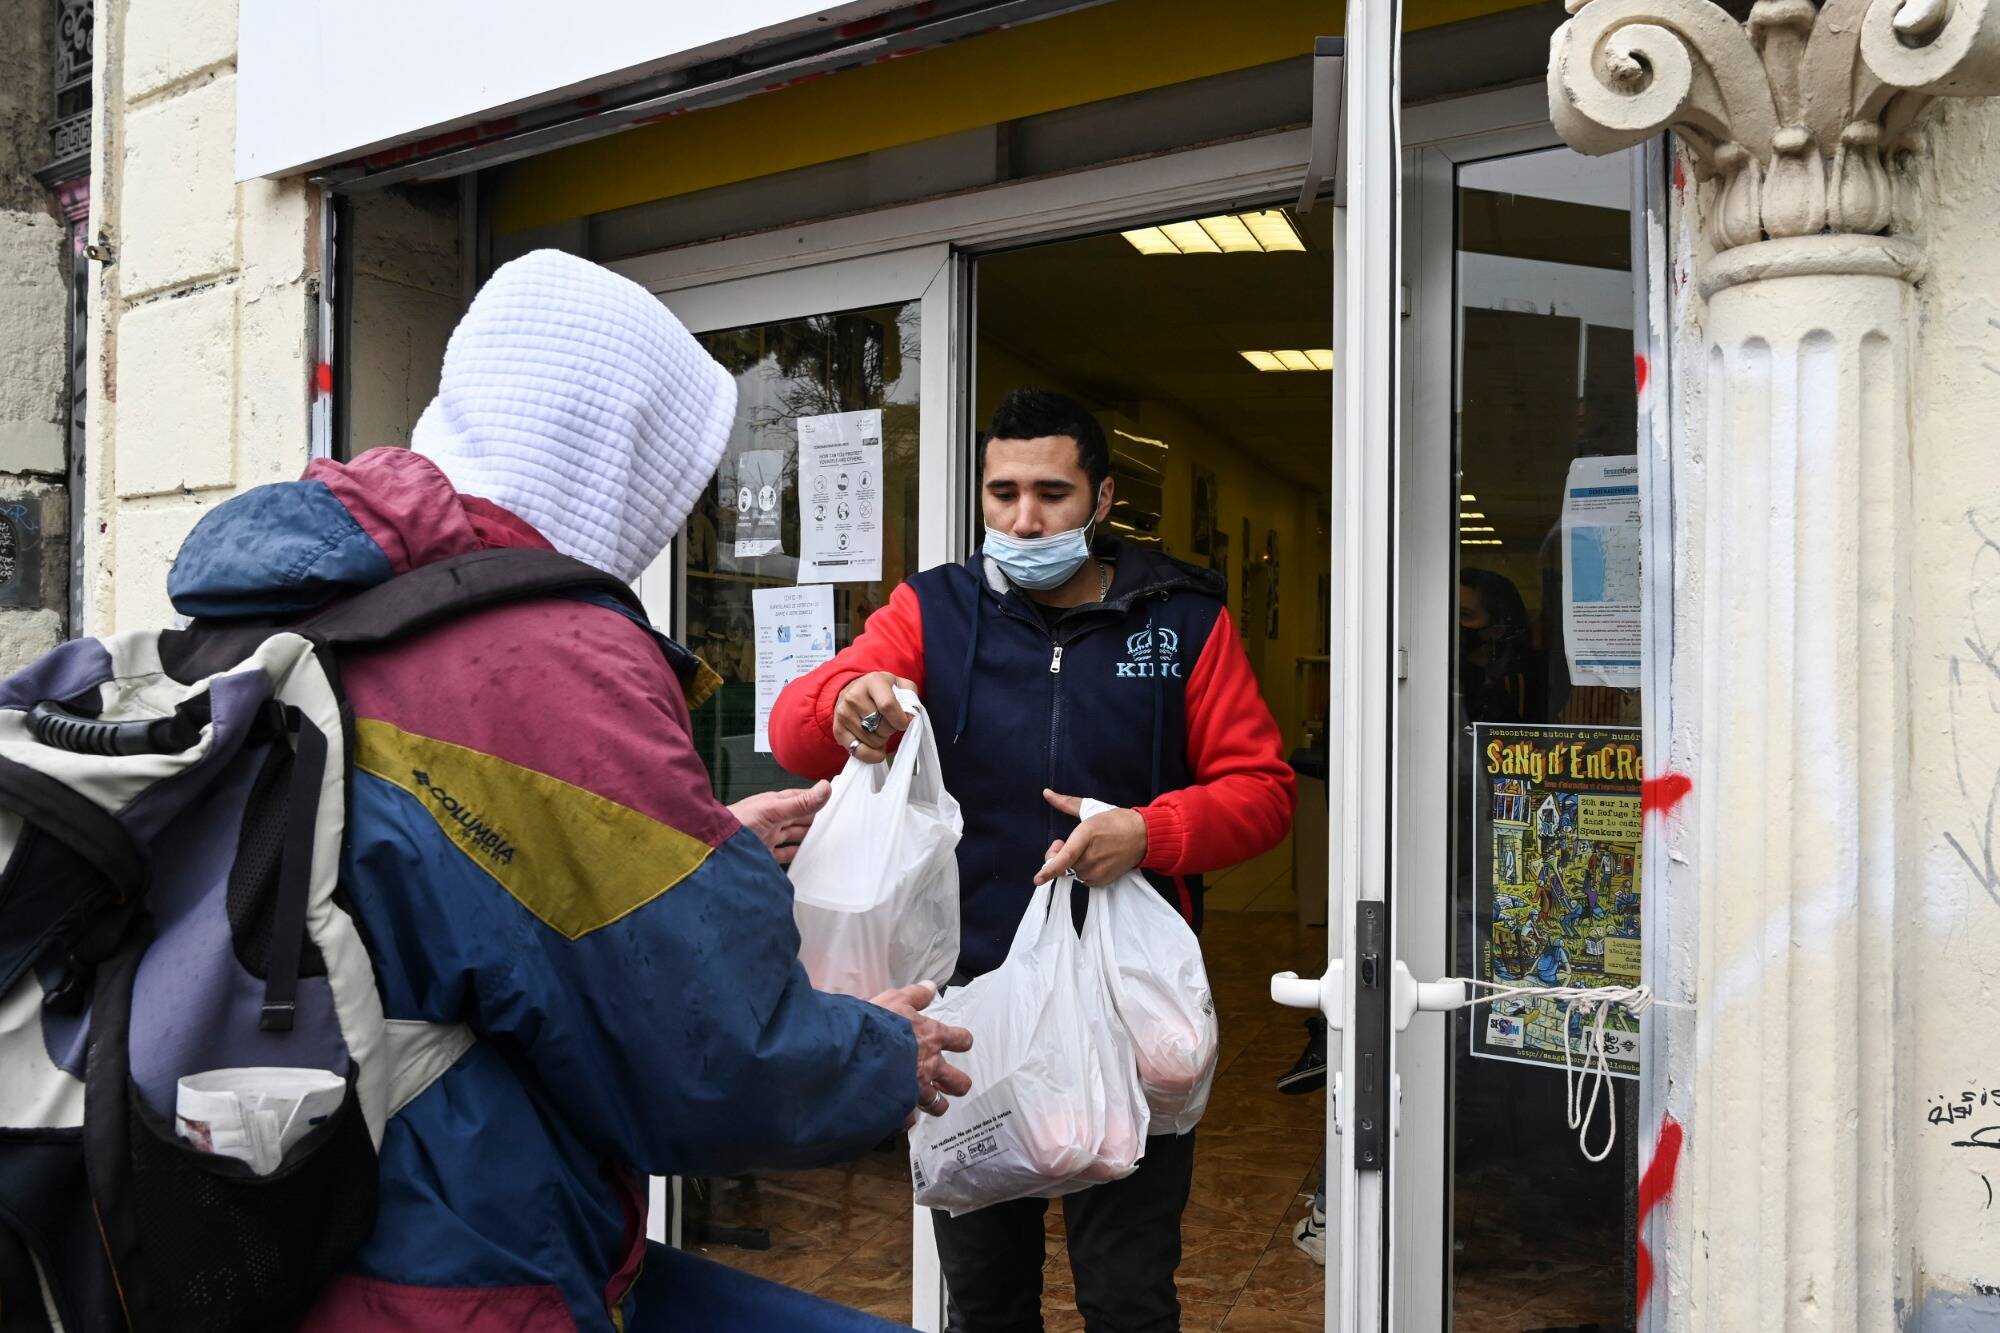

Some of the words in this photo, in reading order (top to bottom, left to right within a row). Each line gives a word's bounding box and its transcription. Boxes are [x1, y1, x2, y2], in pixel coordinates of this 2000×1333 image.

[1489, 728, 1540, 737] Rencontres
[1543, 730, 1574, 739] autour
[1487, 740, 1544, 784] SaNg
[1581, 798, 1597, 806] 20h
[1599, 799, 1615, 807] sur
[1619, 800, 1630, 808] la
[1582, 808, 1594, 816] du
[1597, 809, 1628, 818] Refuge
[431, 787, 516, 863] COLUMBIA
[1583, 818, 1604, 826] dans
[1606, 818, 1616, 826] le
[1579, 827, 1623, 837] Speakers
